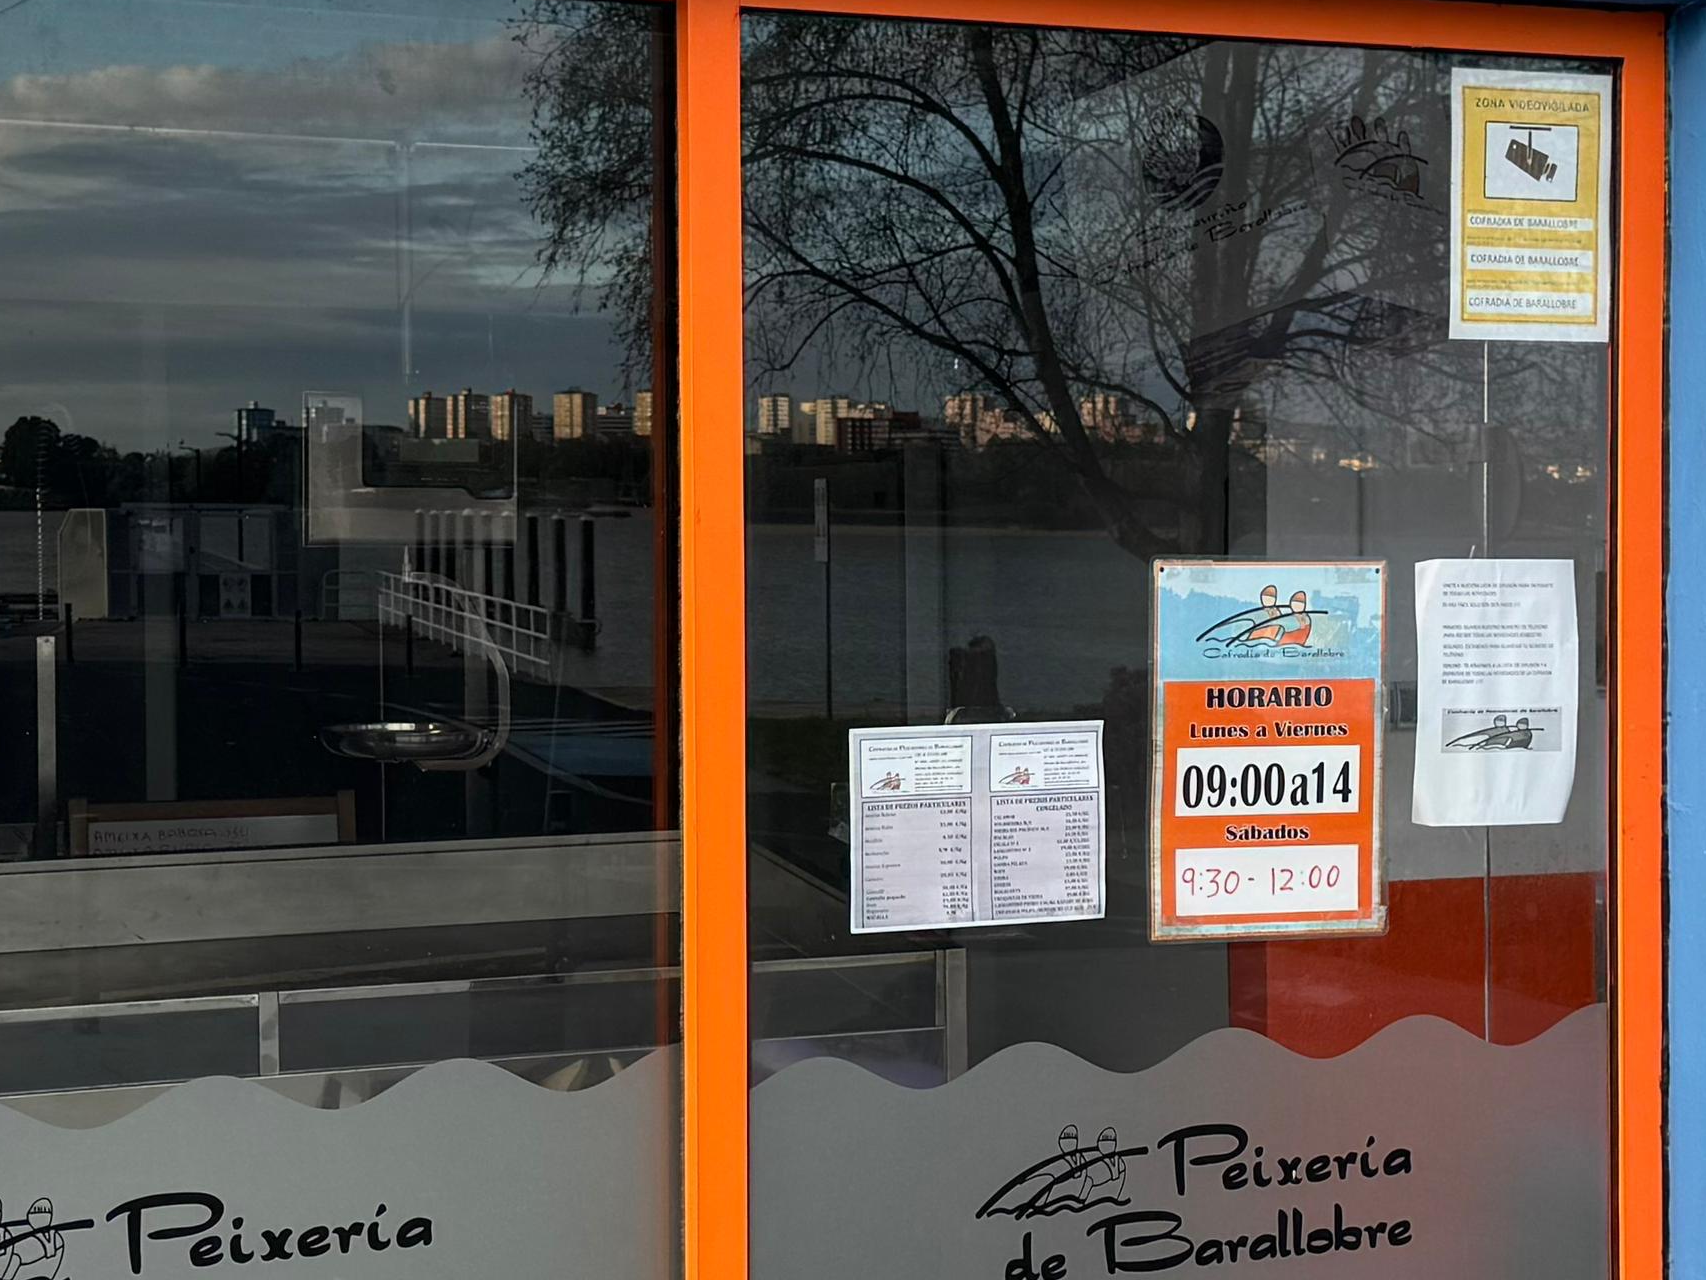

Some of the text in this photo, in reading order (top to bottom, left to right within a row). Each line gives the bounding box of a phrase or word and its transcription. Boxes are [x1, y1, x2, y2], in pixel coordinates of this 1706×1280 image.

[1476, 97, 1505, 108] ZONA
[1206, 686, 1333, 709] HORARIO
[1189, 721, 1349, 739] Lunes a Viernes
[1181, 867, 1241, 898] 9:30
[1270, 864, 1341, 896] 12:00
[1157, 1123, 1413, 1196] Peixería
[106, 1192, 434, 1275] Peixería
[1086, 1203, 1413, 1275] Barallobre
